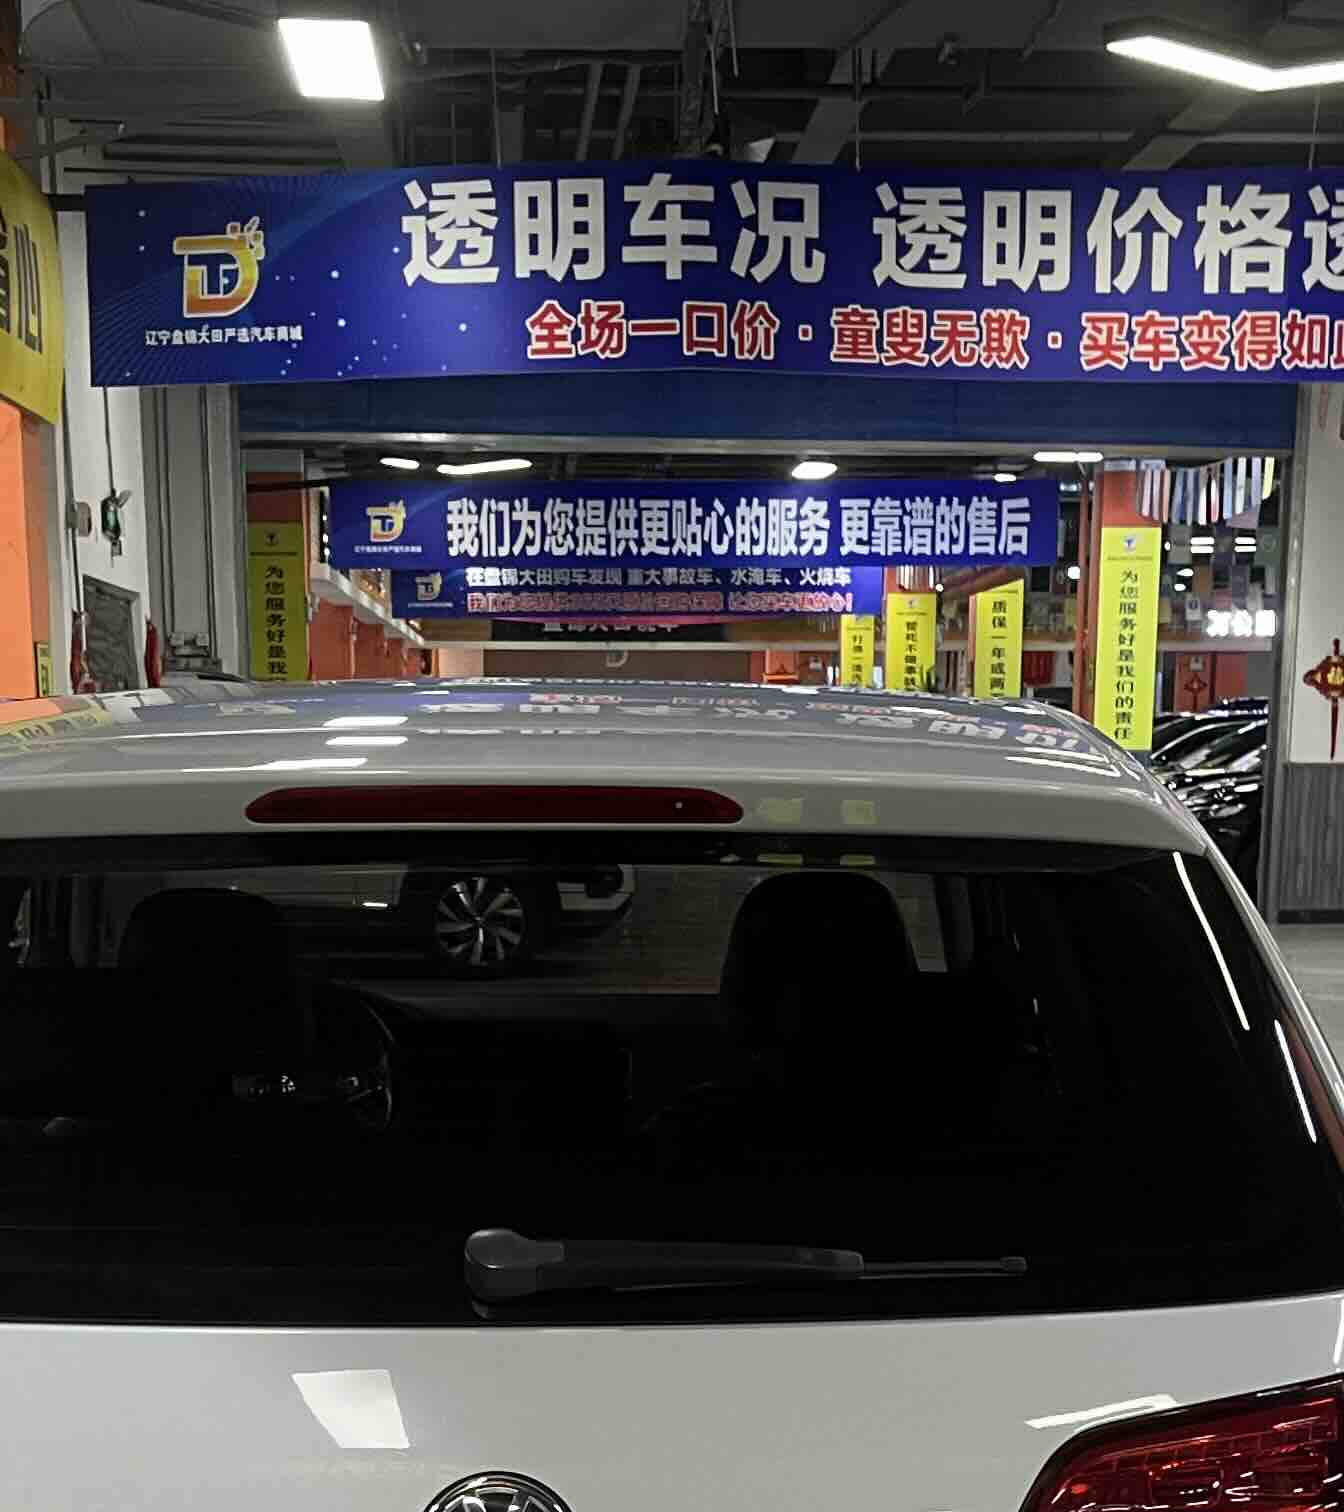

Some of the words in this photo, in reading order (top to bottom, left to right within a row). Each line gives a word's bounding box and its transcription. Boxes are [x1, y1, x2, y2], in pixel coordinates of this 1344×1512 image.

[402, 173, 825, 288] 透明车况
[447, 496, 832, 558] 我们为您提供更贴心的服务
[840, 496, 1031, 557] 更靠谱的售后
[264, 565, 289, 682] 为您服务好是我
